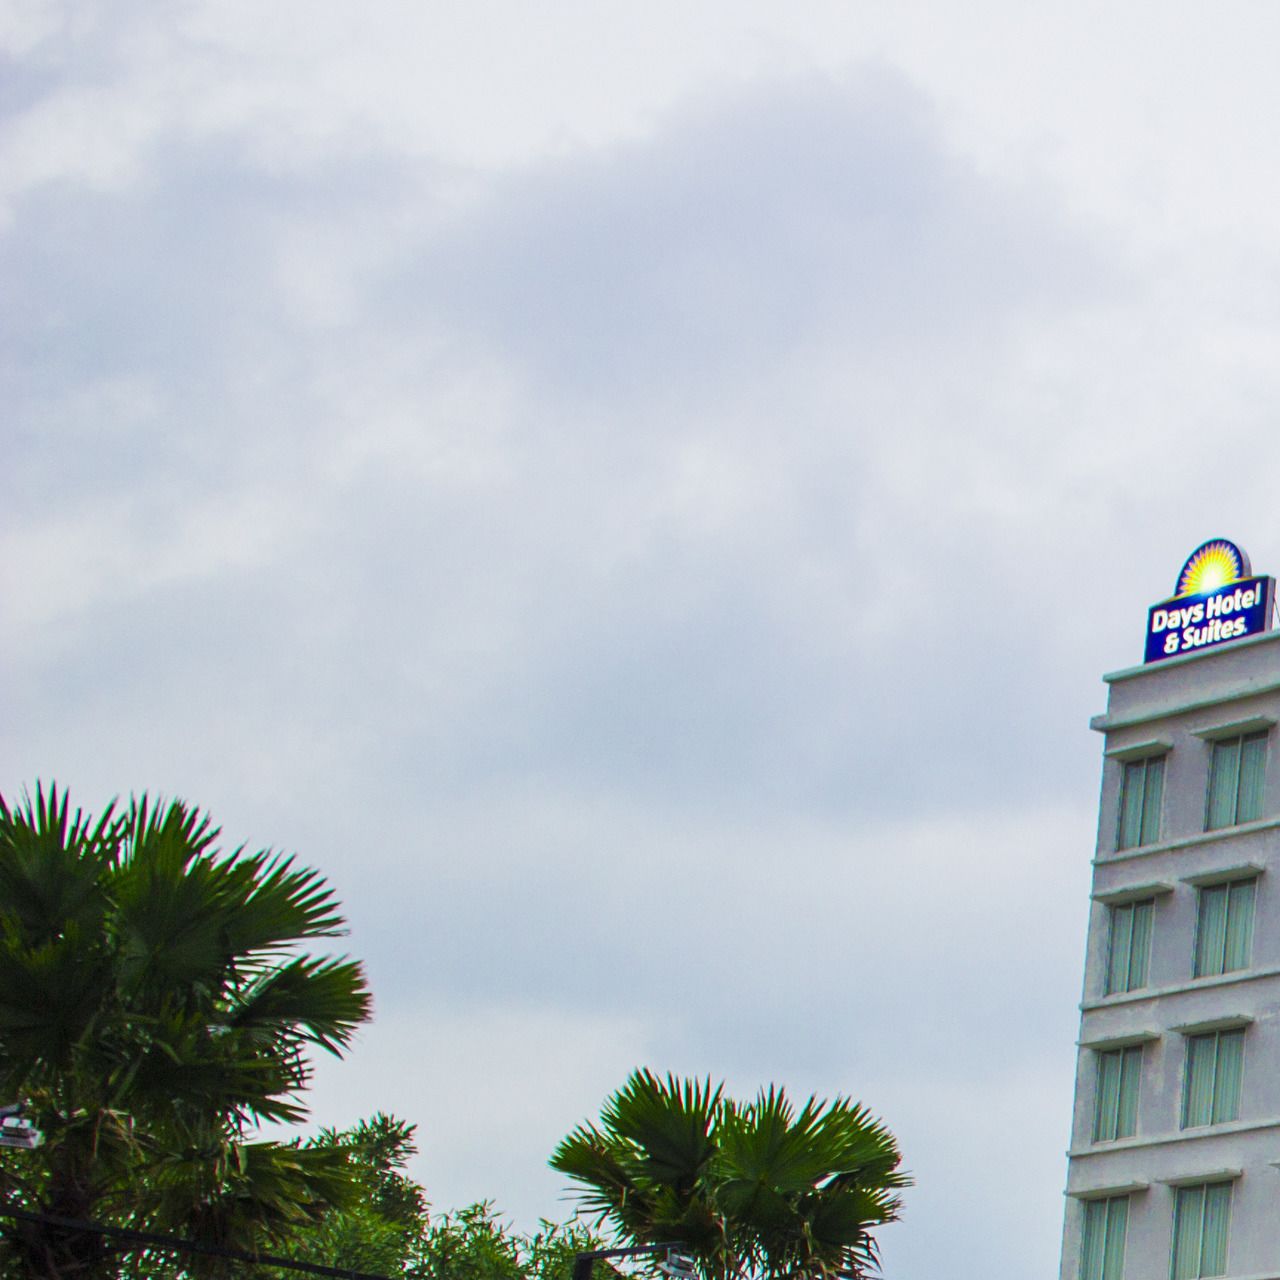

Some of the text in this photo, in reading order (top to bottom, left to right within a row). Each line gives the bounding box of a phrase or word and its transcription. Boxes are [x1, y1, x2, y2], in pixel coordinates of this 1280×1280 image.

[1152, 582, 1261, 633] Days Hotel
[1163, 632, 1180, 655] &
